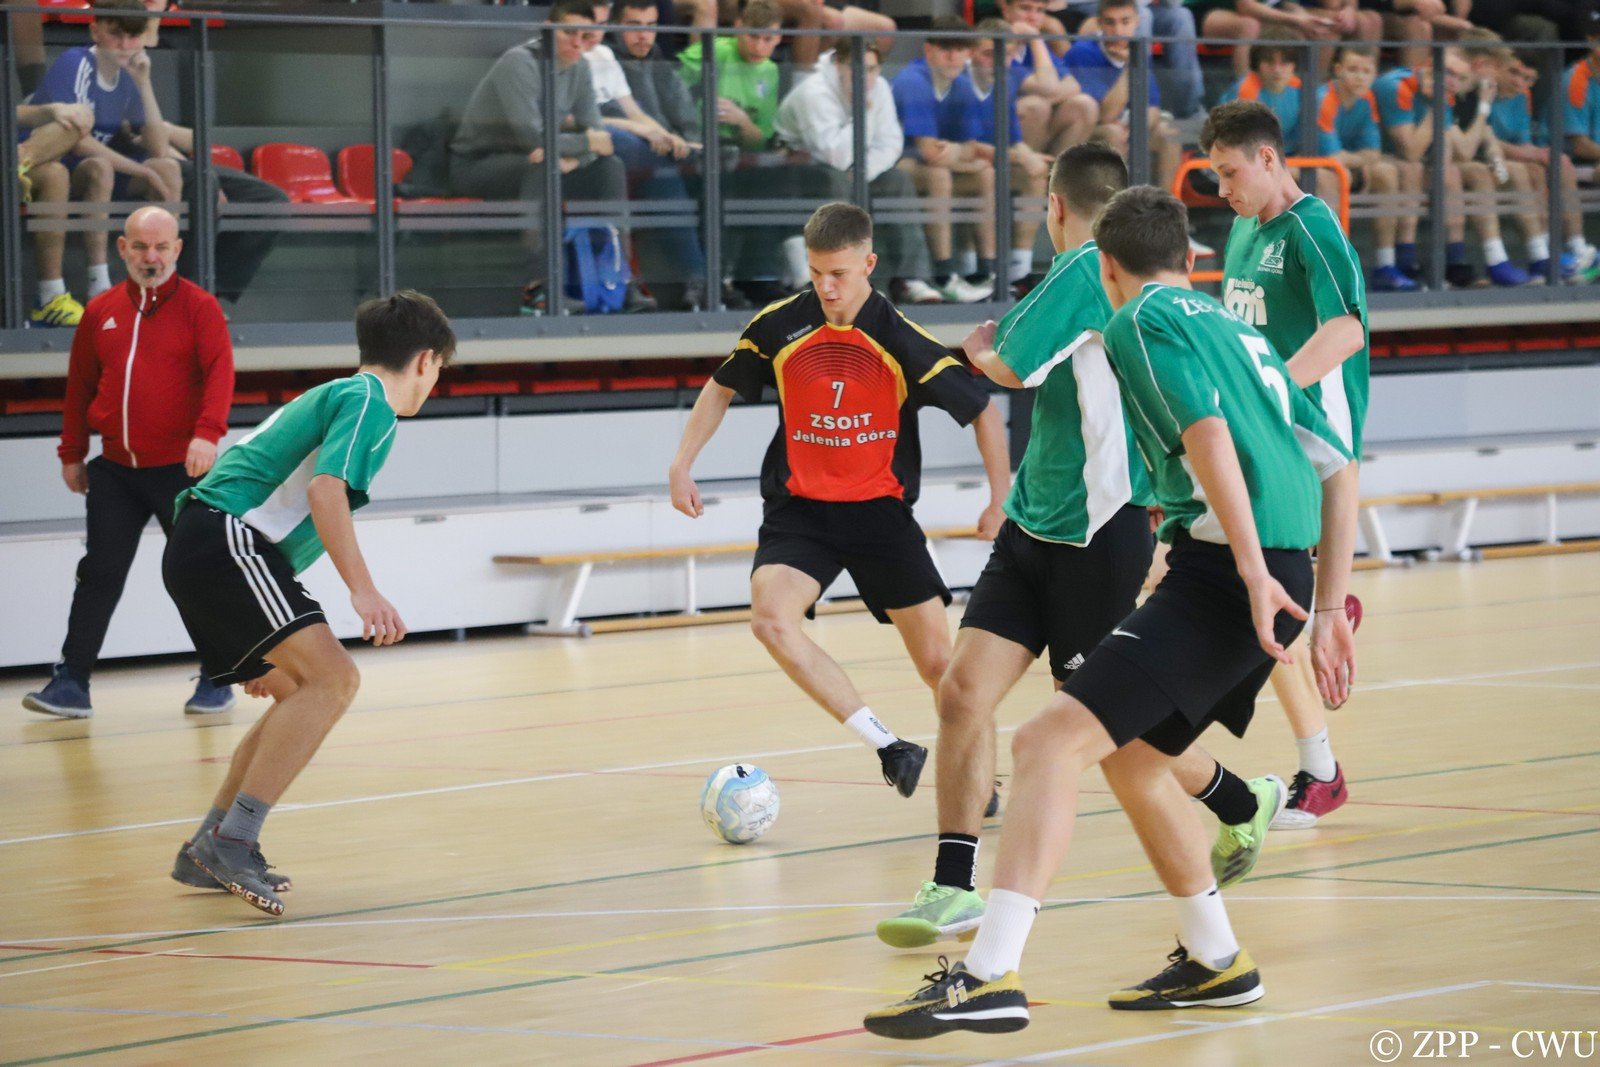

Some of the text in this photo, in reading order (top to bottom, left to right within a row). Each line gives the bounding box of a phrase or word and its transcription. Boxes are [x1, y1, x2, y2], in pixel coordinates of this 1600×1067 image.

[1238, 334, 1292, 426] 5
[831, 381, 845, 409] 7
[810, 413, 872, 430] ZSOiT
[793, 429, 897, 447] Jelenia Góra
